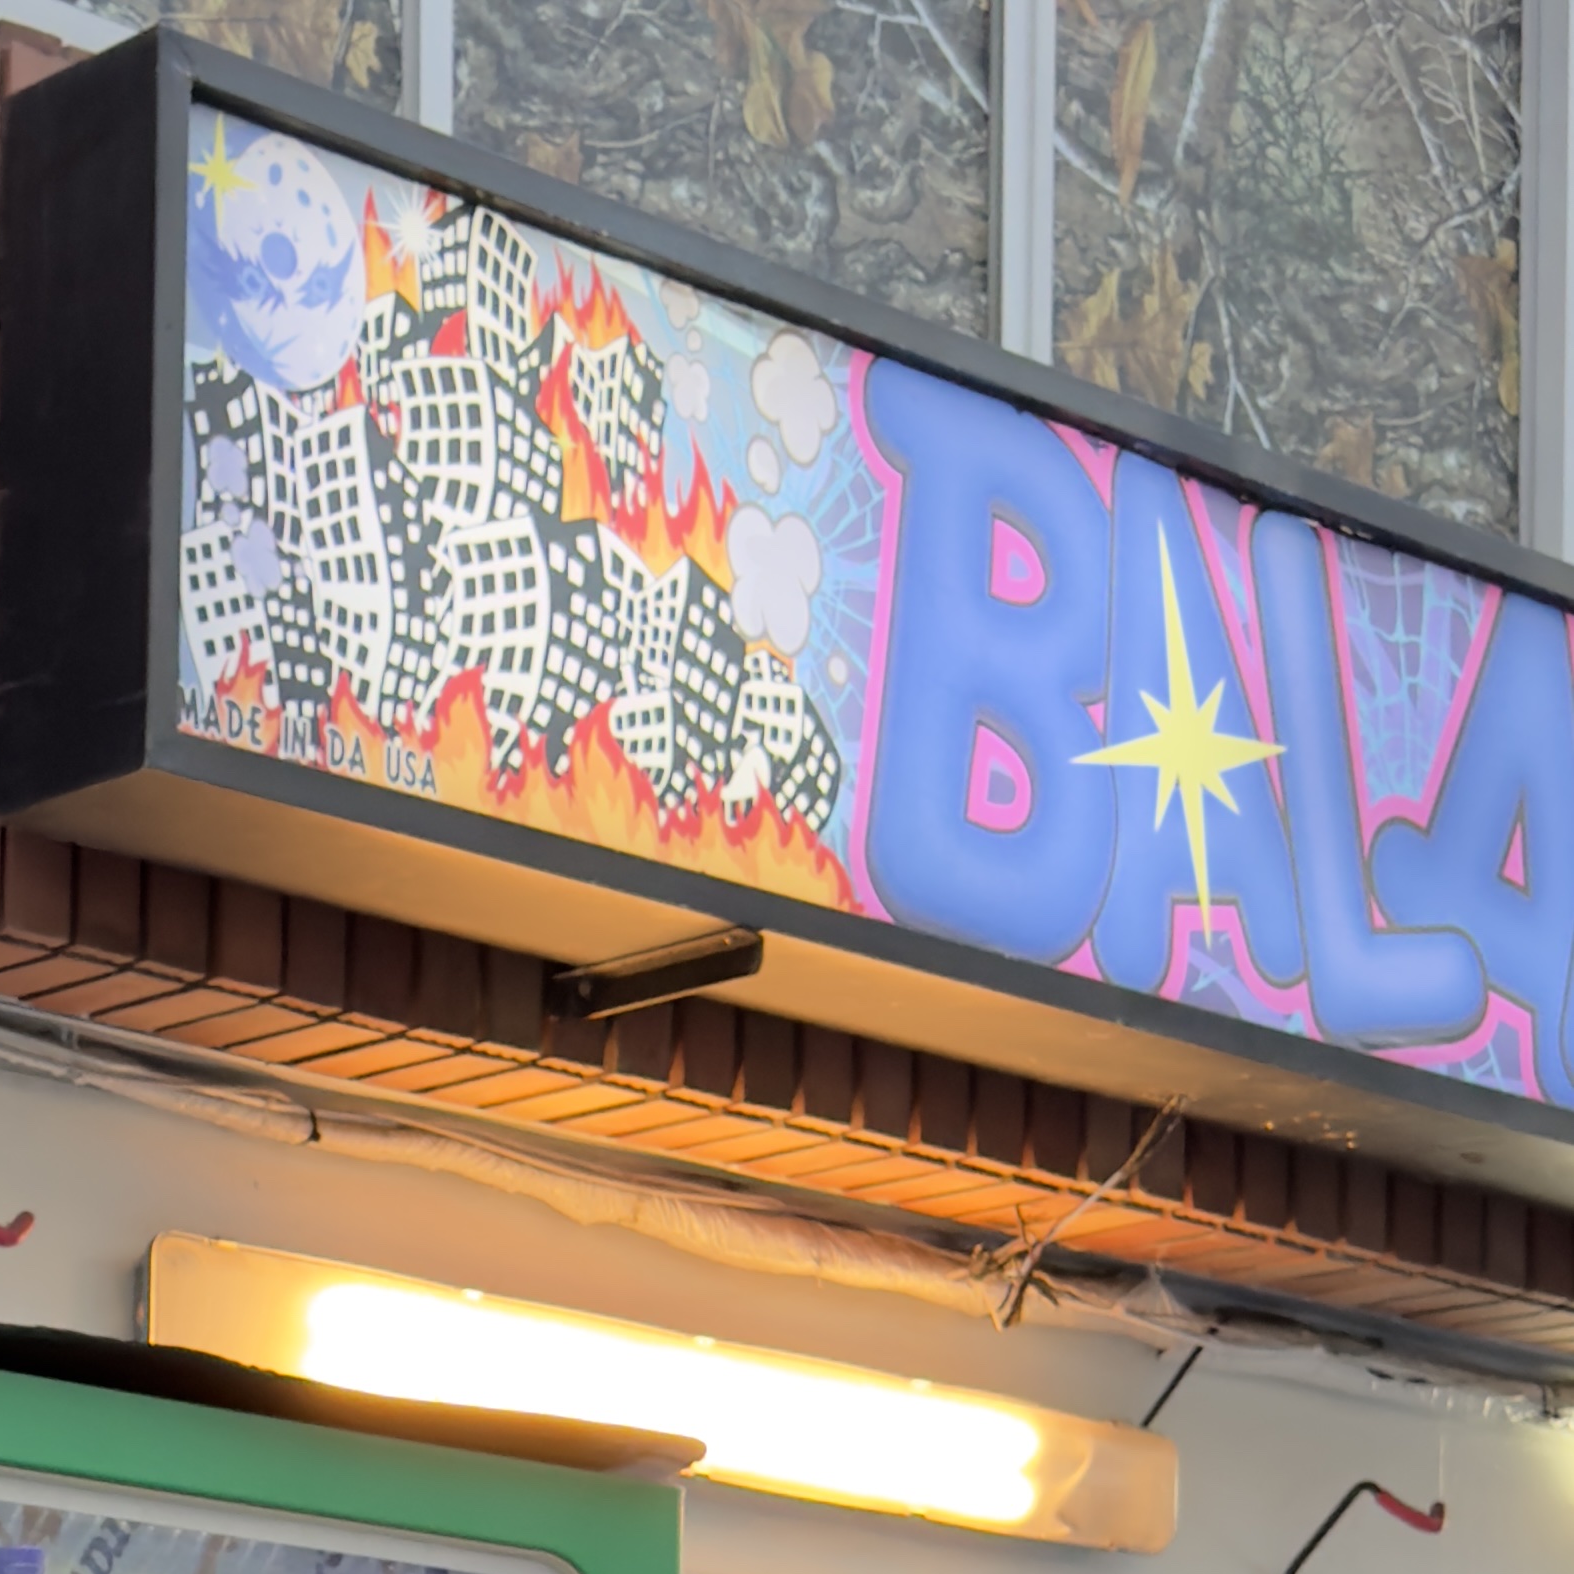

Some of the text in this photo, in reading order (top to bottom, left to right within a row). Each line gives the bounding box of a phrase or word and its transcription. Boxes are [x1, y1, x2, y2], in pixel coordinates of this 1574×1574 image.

[179, 686, 439, 794] MADE IN DA USA
